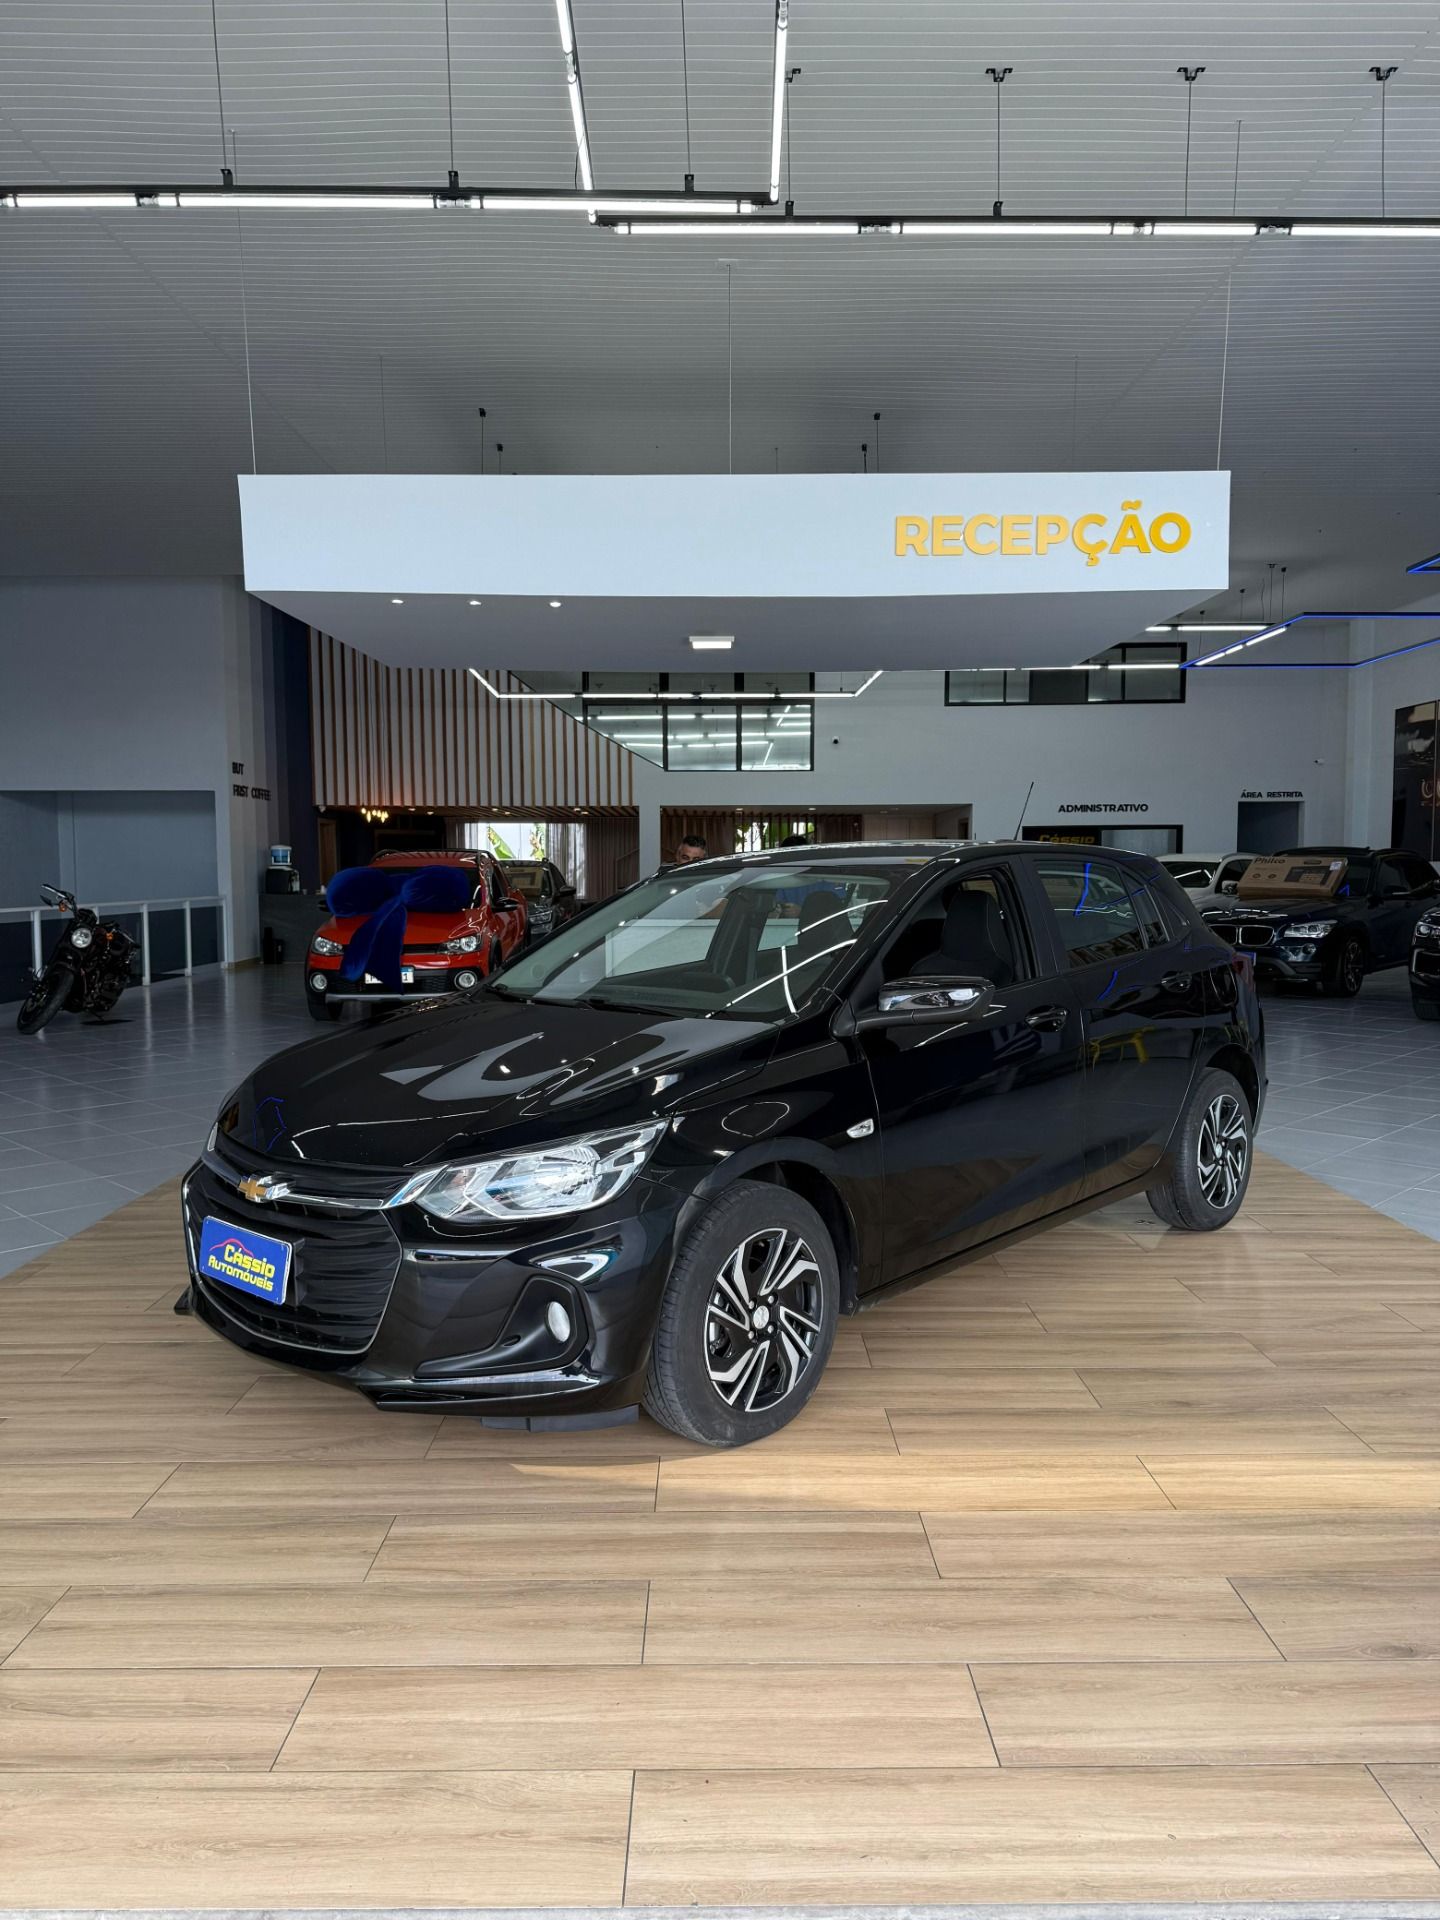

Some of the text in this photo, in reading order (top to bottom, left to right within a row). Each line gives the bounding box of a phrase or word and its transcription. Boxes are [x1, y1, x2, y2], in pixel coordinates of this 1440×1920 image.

[895, 500, 1192, 566] RECEPÇÃO
[232, 761, 244, 775] BUT
[1241, 789, 1263, 798] ÁREA
[1058, 803, 1149, 813] ADMINISTRATIVO
